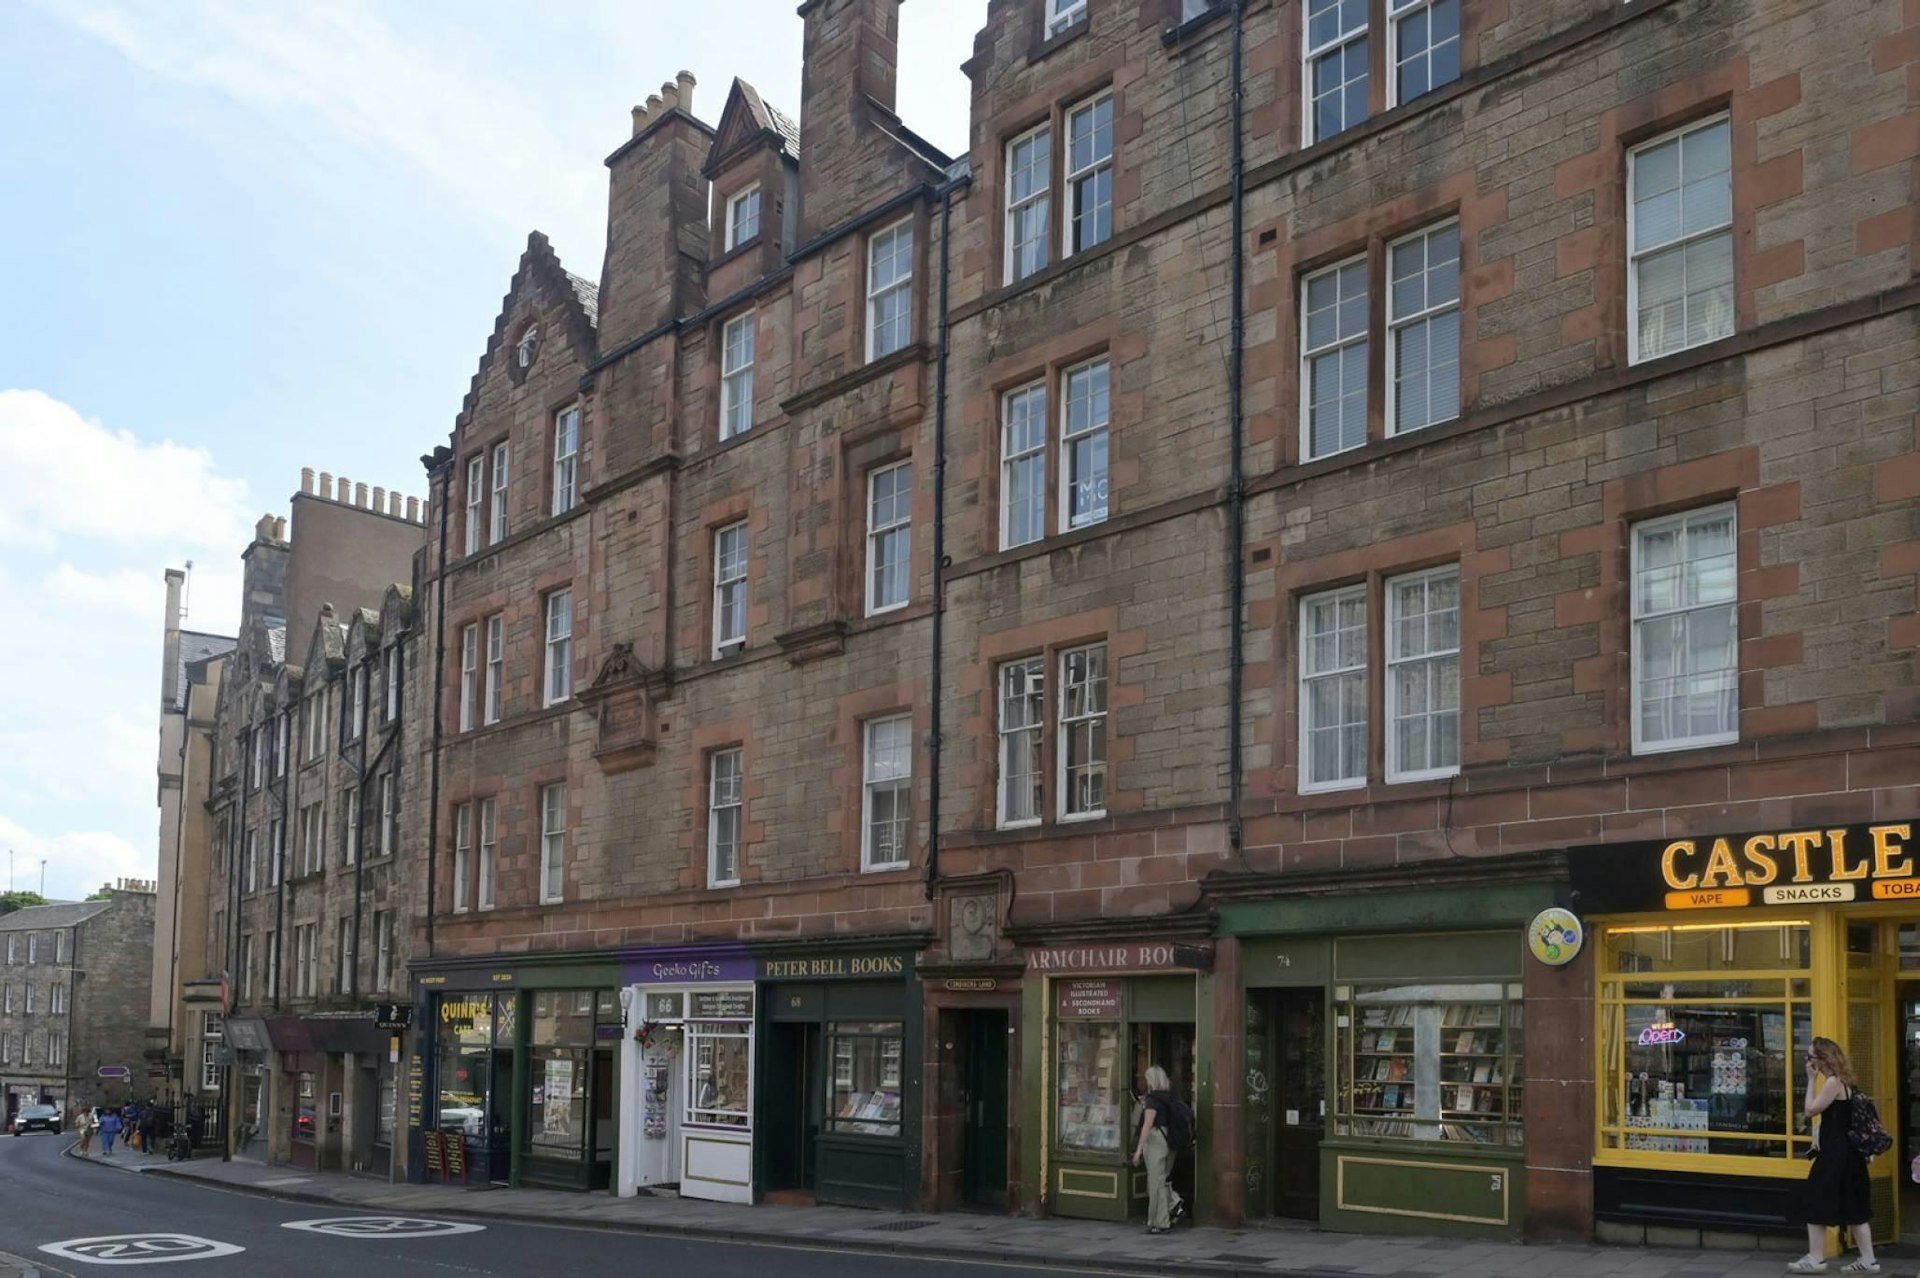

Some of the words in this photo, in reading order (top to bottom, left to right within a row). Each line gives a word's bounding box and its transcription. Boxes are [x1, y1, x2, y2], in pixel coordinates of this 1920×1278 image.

[1661, 824, 1913, 890] CASTLE
[1690, 893, 1723, 905] VAPE
[1775, 887, 1842, 901] SNACKS
[766, 961, 808, 977] PETER
[811, 959, 846, 976] BELL
[851, 956, 903, 974] BOOKS
[1027, 948, 1128, 969] ARMCHAIR
[653, 962, 687, 980] Gecko
[689, 960, 720, 980] Gifts
[1072, 982, 1106, 990] VICTORIAN
[441, 1002, 488, 1022] QUINN'S
[658, 998, 672, 1013] 66
[1072, 999, 1116, 1007] SECONDHAND
[1642, 1028, 1676, 1045] Open
[75, 1239, 206, 1258] 20
